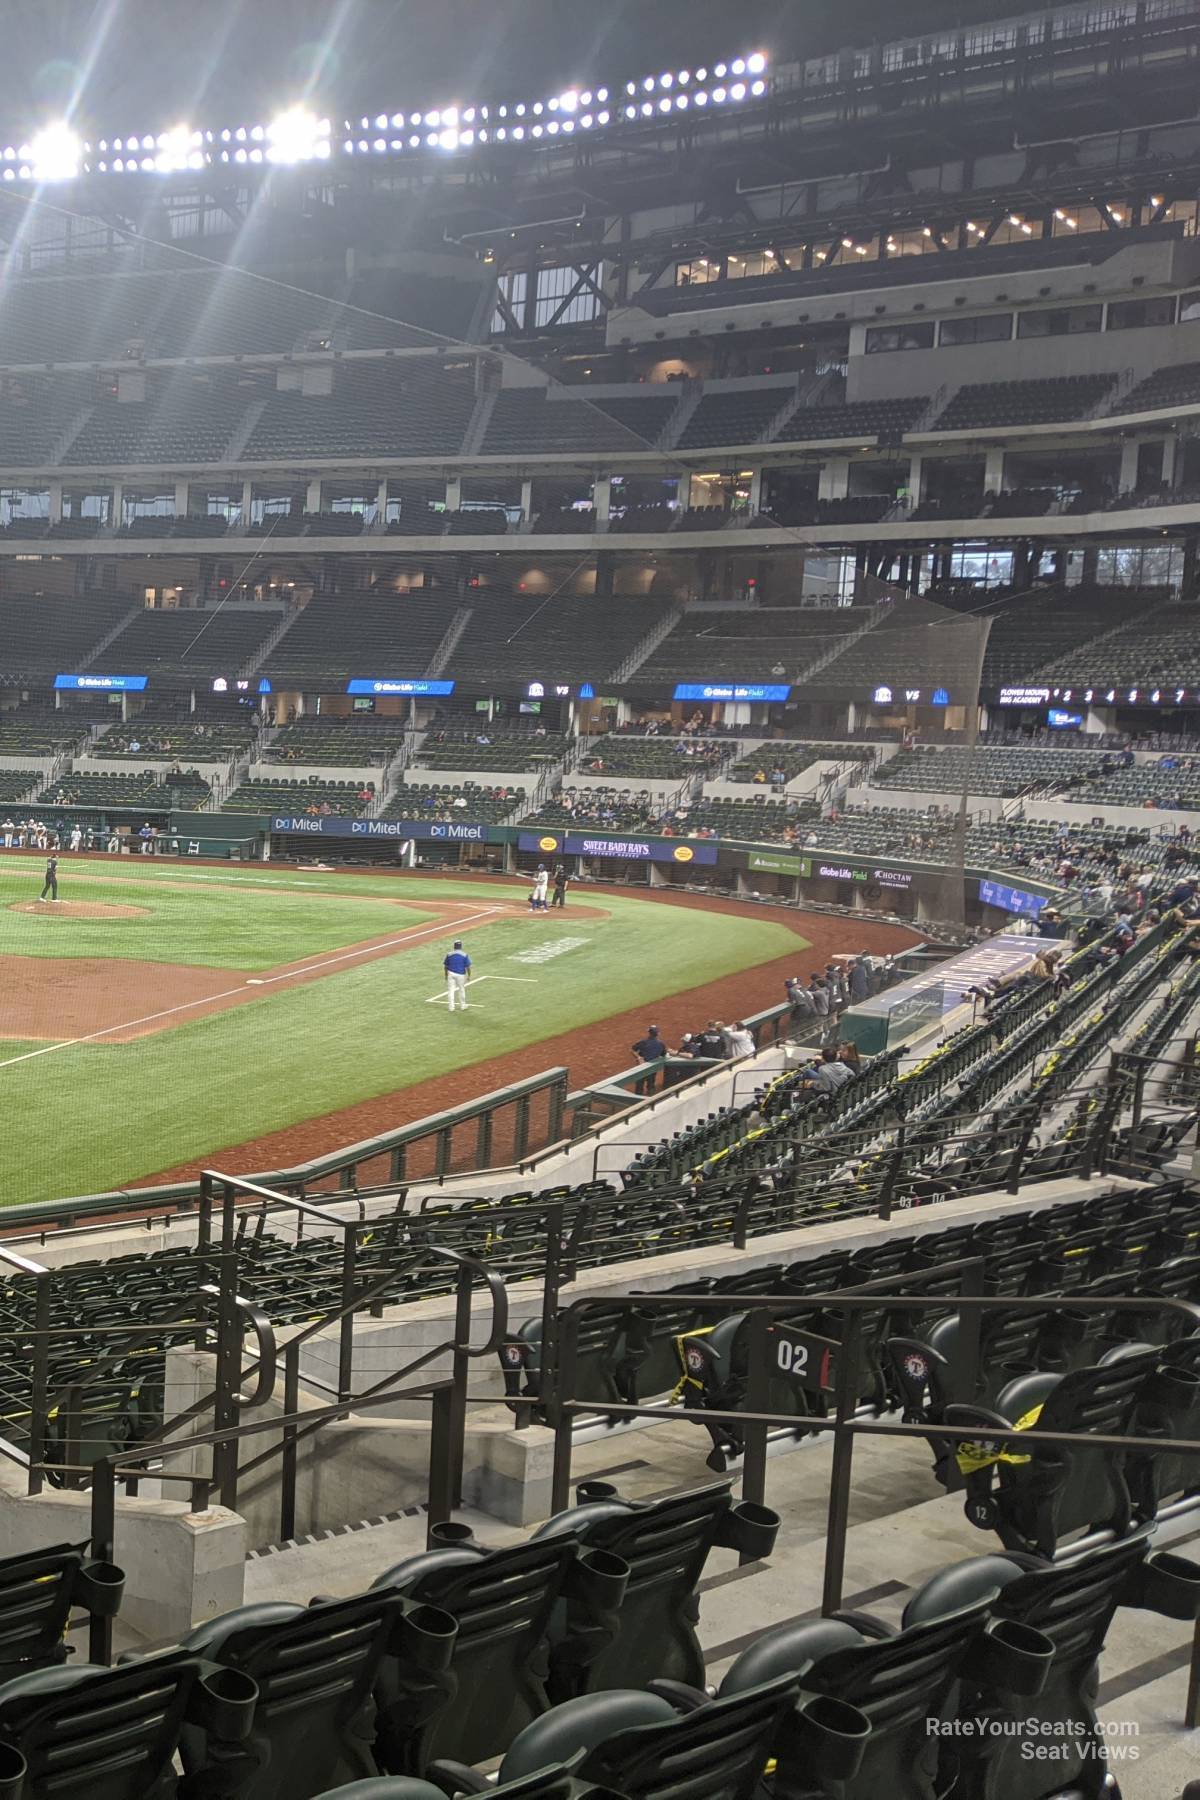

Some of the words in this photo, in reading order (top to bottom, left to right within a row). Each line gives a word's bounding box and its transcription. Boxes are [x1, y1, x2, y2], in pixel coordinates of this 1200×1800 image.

[237, 681, 248, 689] VS
[556, 685, 569, 695] VS
[905, 691, 920, 700] VS
[1063, 690, 1072, 702] 2
[1085, 690, 1093, 702] 3
[1107, 690, 1115, 702] 4
[1129, 690, 1137, 702] 5
[1152, 690, 1160, 702] 6
[1176, 690, 1185, 702] 7
[292, 818, 323, 831] Mitel
[368, 822, 401, 835] Mitel
[448, 825, 482, 838] Mitel
[583, 840, 608, 851] SWEET
[608, 841, 628, 853] BABY
[819, 866, 840, 878] Globe
[839, 869, 852, 879] Life
[852, 870, 868, 881] Field
[900, 1196, 912, 1209] 03
[777, 1340, 809, 1377] 02
[975, 1506, 987, 1521] 12
